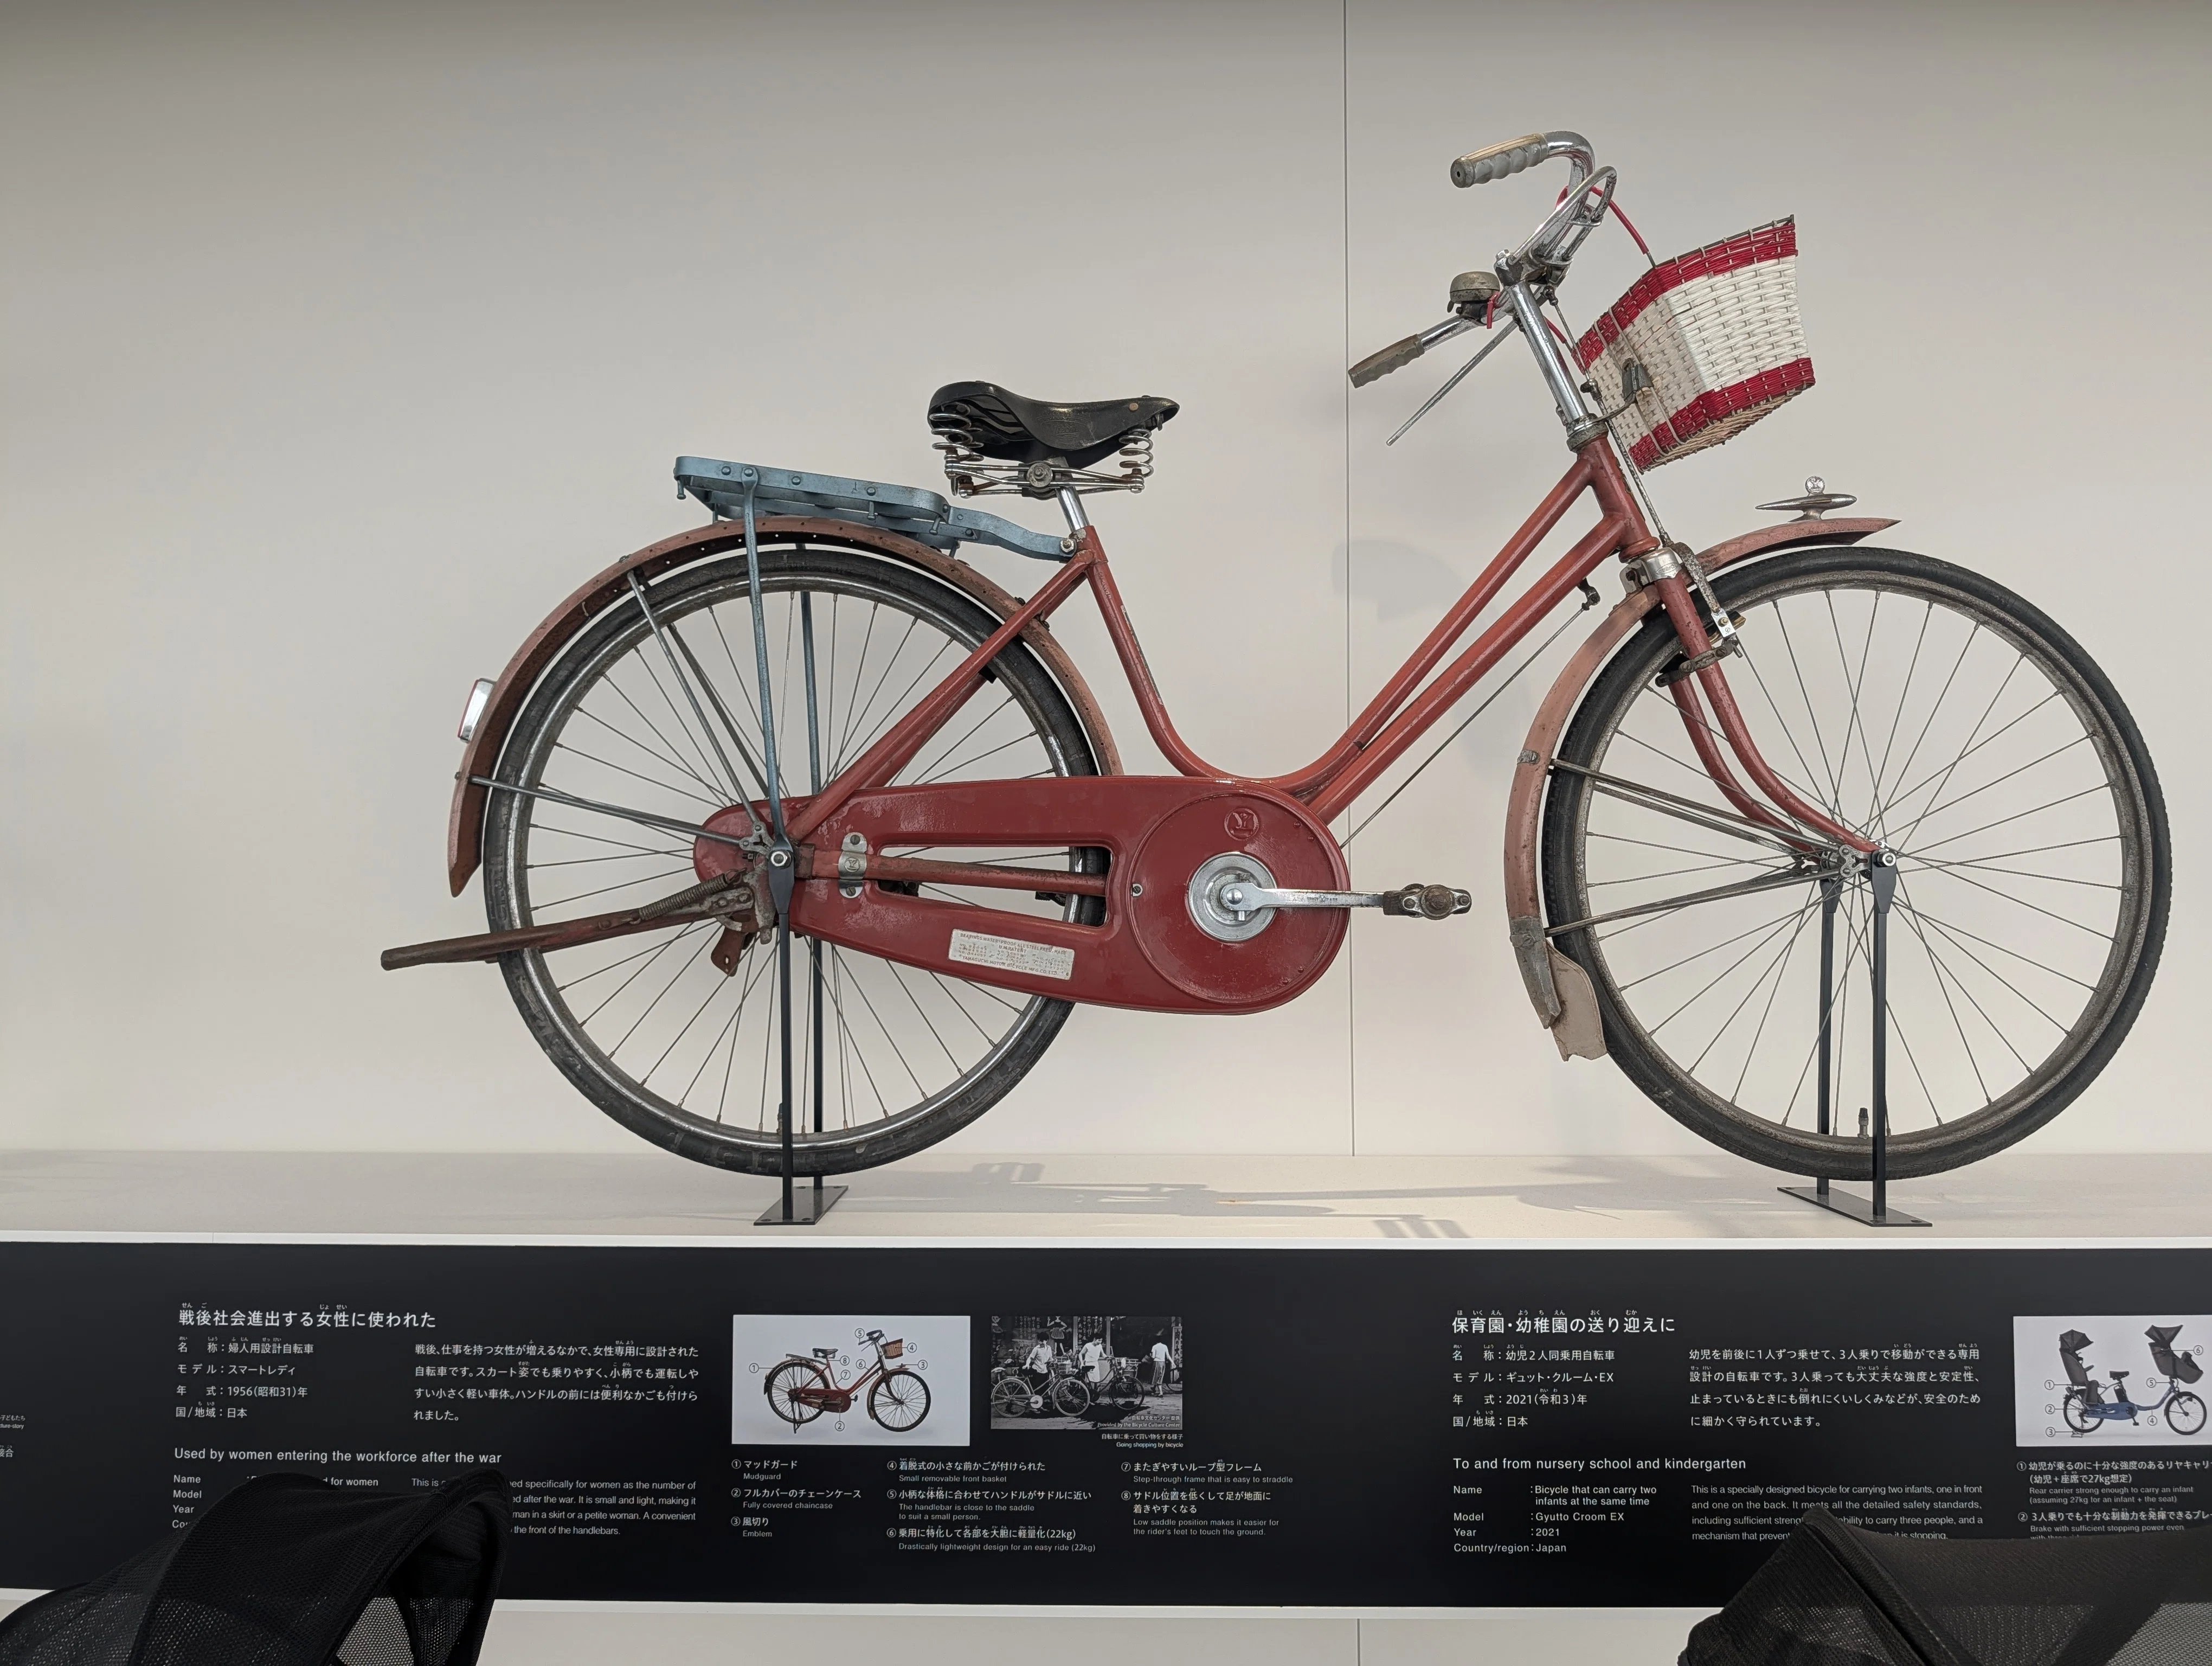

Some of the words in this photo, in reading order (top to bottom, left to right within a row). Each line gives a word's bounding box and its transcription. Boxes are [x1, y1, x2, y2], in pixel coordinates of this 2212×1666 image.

[175, 1447, 205, 1459] Used
[210, 1448, 224, 1462] by
[229, 1451, 272, 1460] women
[277, 1450, 327, 1464] entering
[332, 1450, 352, 1462] the
[356, 1451, 417, 1463] workforce
[421, 1451, 451, 1463] after
[454, 1452, 474, 1463] the
[479, 1454, 502, 1464] war
[1452, 1458, 1469, 1469] To
[1474, 1458, 1497, 1469] and
[1502, 1458, 1531, 1469] from
[1536, 1460, 1585, 1472] nursery
[1590, 1458, 1631, 1469] school
[1636, 1458, 1660, 1469] and
[1665, 1458, 1746, 1472] kindergarten
[2029, 1461, 2212, 1471] 幼児が乗るのに十分な強度のあるリヤキャリ
[173, 1475, 201, 1484] Name
[331, 1477, 344, 1486] for
[743, 1472, 781, 1482] Mudguard
[173, 1489, 202, 1499] Model
[1454, 1485, 1482, 1494] Name
[1572, 1485, 1590, 1494] that
[1613, 1487, 1637, 1496] carry
[1640, 1486, 1657, 1494] two
[1691, 1485, 1709, 1494] This
[1711, 1485, 1718, 1494] is
[1727, 1485, 1764, 1496] specially
[1766, 1485, 1805, 1496] designed
[1807, 1485, 1837, 1496] bicycle
[1838, 1485, 1850, 1494] for
[1852, 1485, 1886, 1496] carrying
[1888, 1485, 1903, 1494] two
[1905, 1485, 1934, 1494] infants,
[1954, 1484, 1962, 1493] in
[1963, 1484, 1983, 1494] front
[2075, 1487, 2099, 1495] strong
[2101, 1486, 2129, 1495] enough
[743, 1501, 761, 1510] Fully
[1535, 1497, 1567, 1505] infants
[1571, 1497, 1580, 1505] at
[1583, 1497, 1598, 1505] the
[1629, 1497, 1650, 1505] time
[172, 1504, 195, 1514] Year
[1454, 1513, 1484, 1521] Model
[1573, 1512, 1606, 1521] Croom
[1610, 1512, 1624, 1521] EX
[2031, 1511, 2212, 1521] 3人乗りでも十分な制動力を発揮できるブレ
[514, 1525, 527, 1534] the
[529, 1525, 546, 1534] front
[548, 1526, 557, 1534] of
[558, 1526, 571, 1534] the
[573, 1526, 620, 1535] handlebars.
[1454, 1528, 1477, 1537] Year
[898, 1543, 938, 1552] Drastically
[940, 1543, 981, 1552] lightweight
[983, 1543, 1008, 1552] design
[1071, 1543, 1096, 1553] (22kg)
[1454, 1543, 1529, 1554] Country/region
